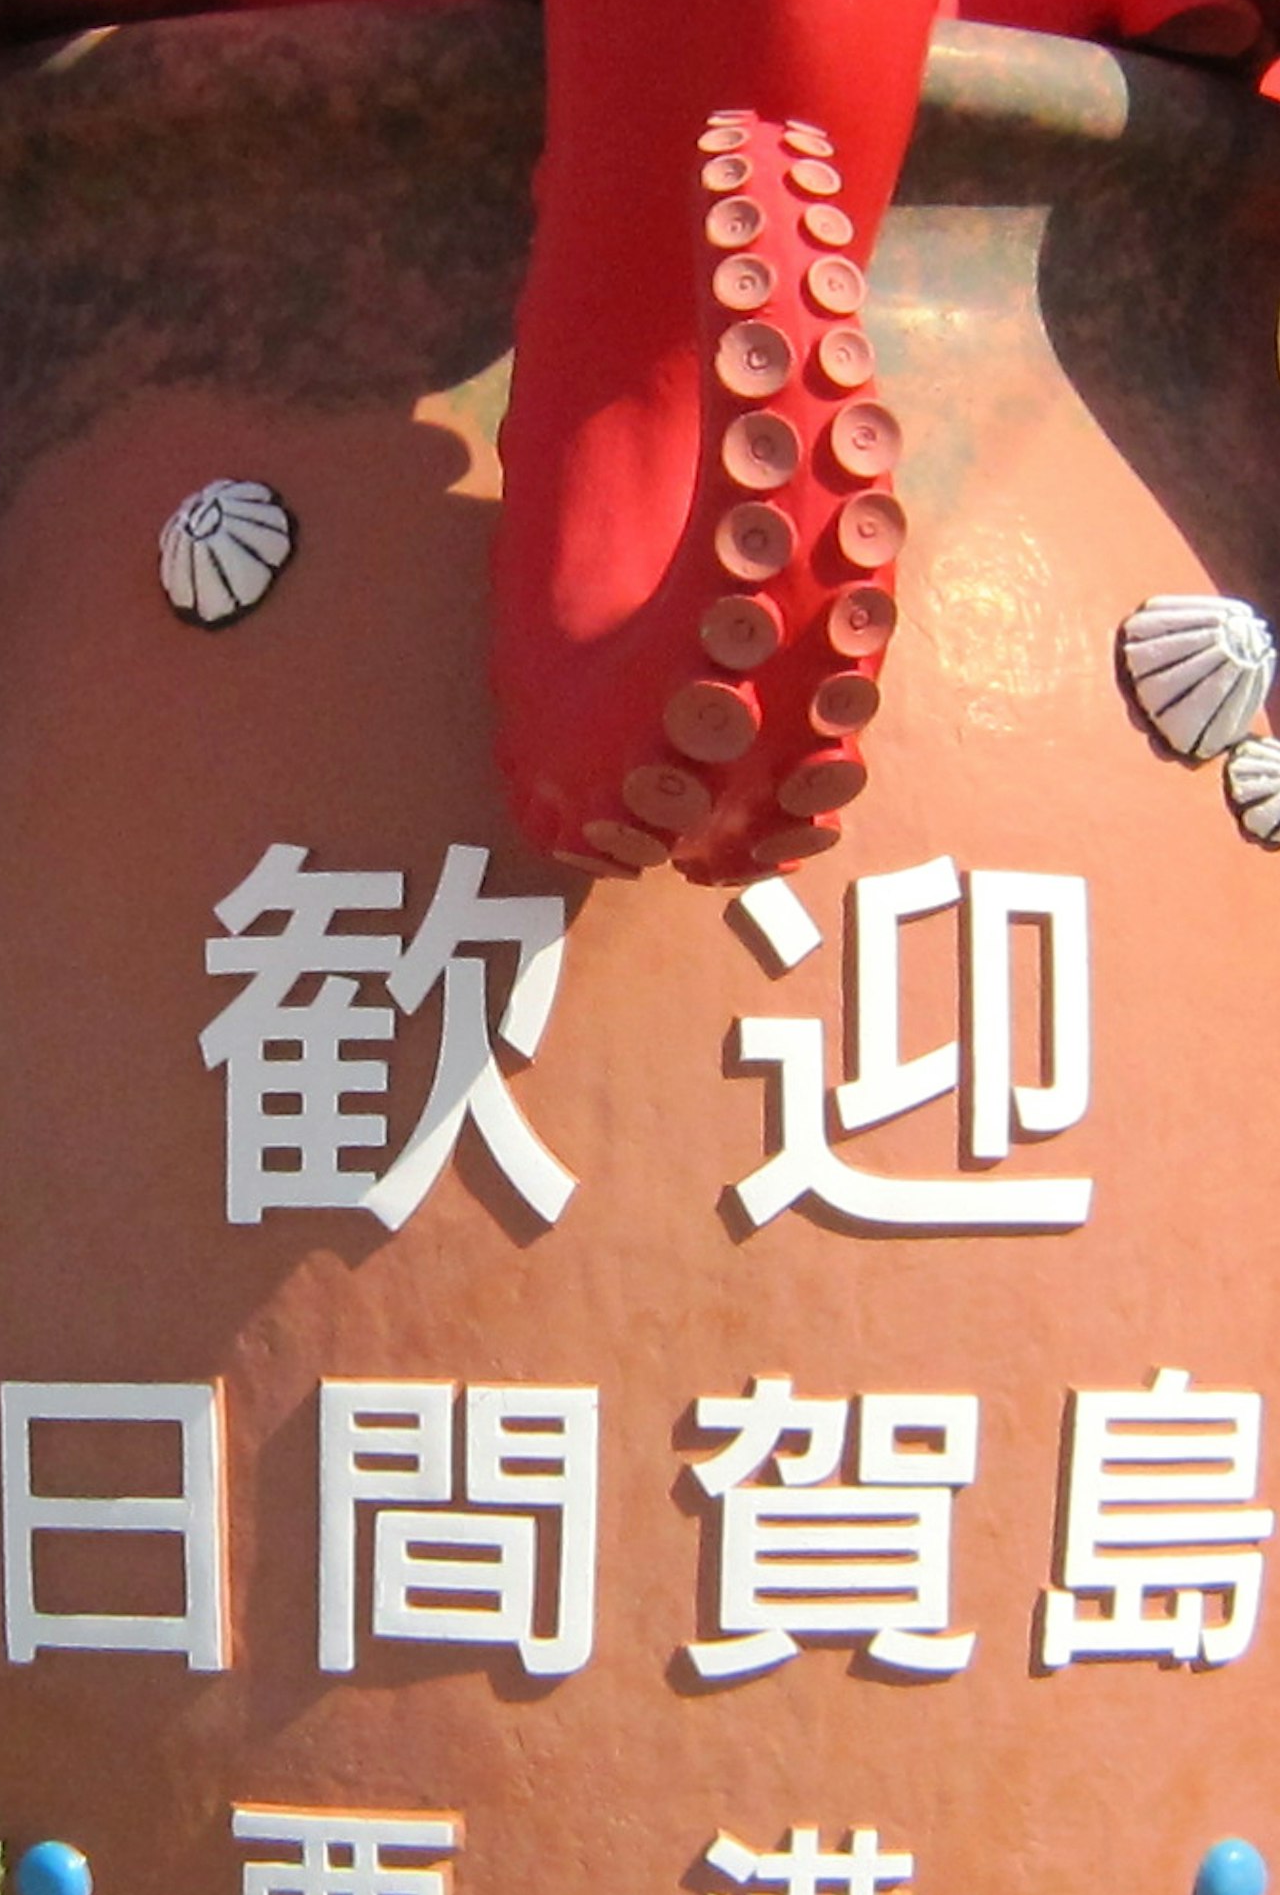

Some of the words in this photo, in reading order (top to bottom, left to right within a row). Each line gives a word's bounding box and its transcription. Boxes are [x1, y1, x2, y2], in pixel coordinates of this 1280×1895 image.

[199, 843, 1094, 1230] 歓迎
[0, 1368, 1273, 1679] 日間賀島
